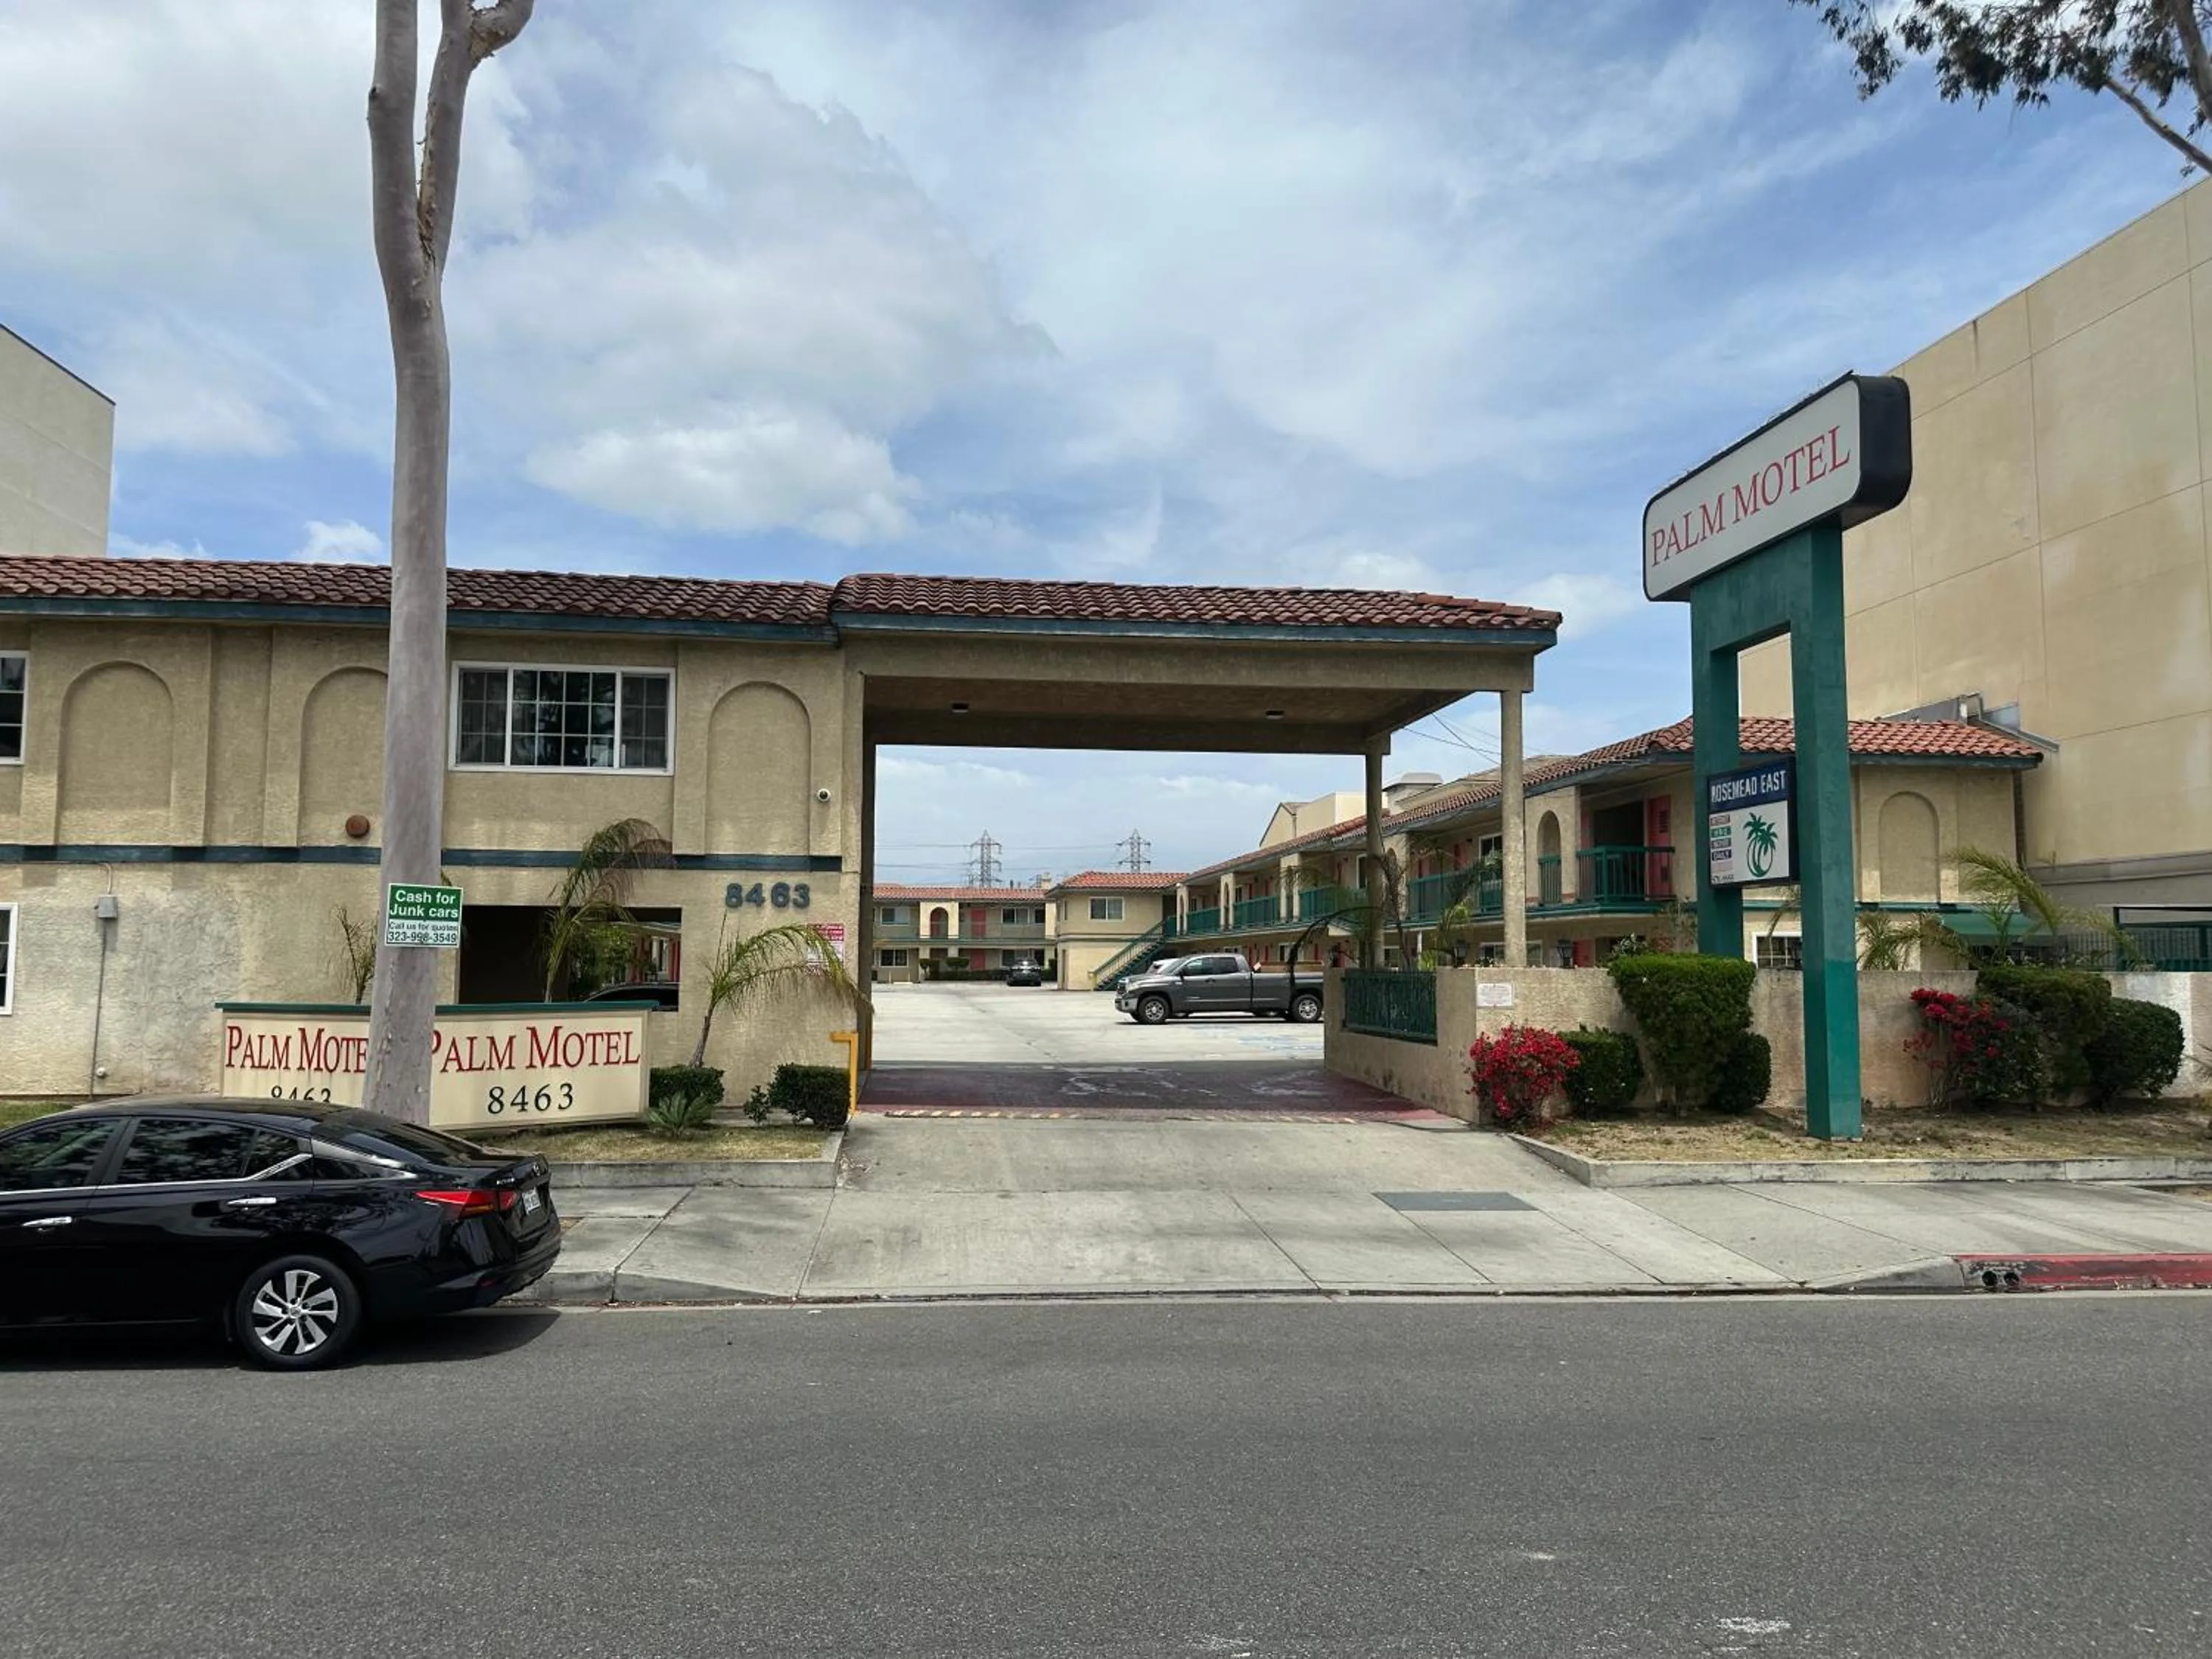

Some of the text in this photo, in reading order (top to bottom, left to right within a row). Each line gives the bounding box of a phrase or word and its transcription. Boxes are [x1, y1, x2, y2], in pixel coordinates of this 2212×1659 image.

[1651, 425, 1851, 567] PALM MOTEL
[1711, 770, 1786, 803] ROSEMEAD EAST
[390, 903, 459, 918] Junk cars
[395, 890, 456, 905] Cash for
[726, 882, 810, 908] 8463
[226, 1026, 369, 1074] PALM MOTE
[526, 1026, 641, 1068] MOTEL
[487, 1082, 573, 1114] 8463
